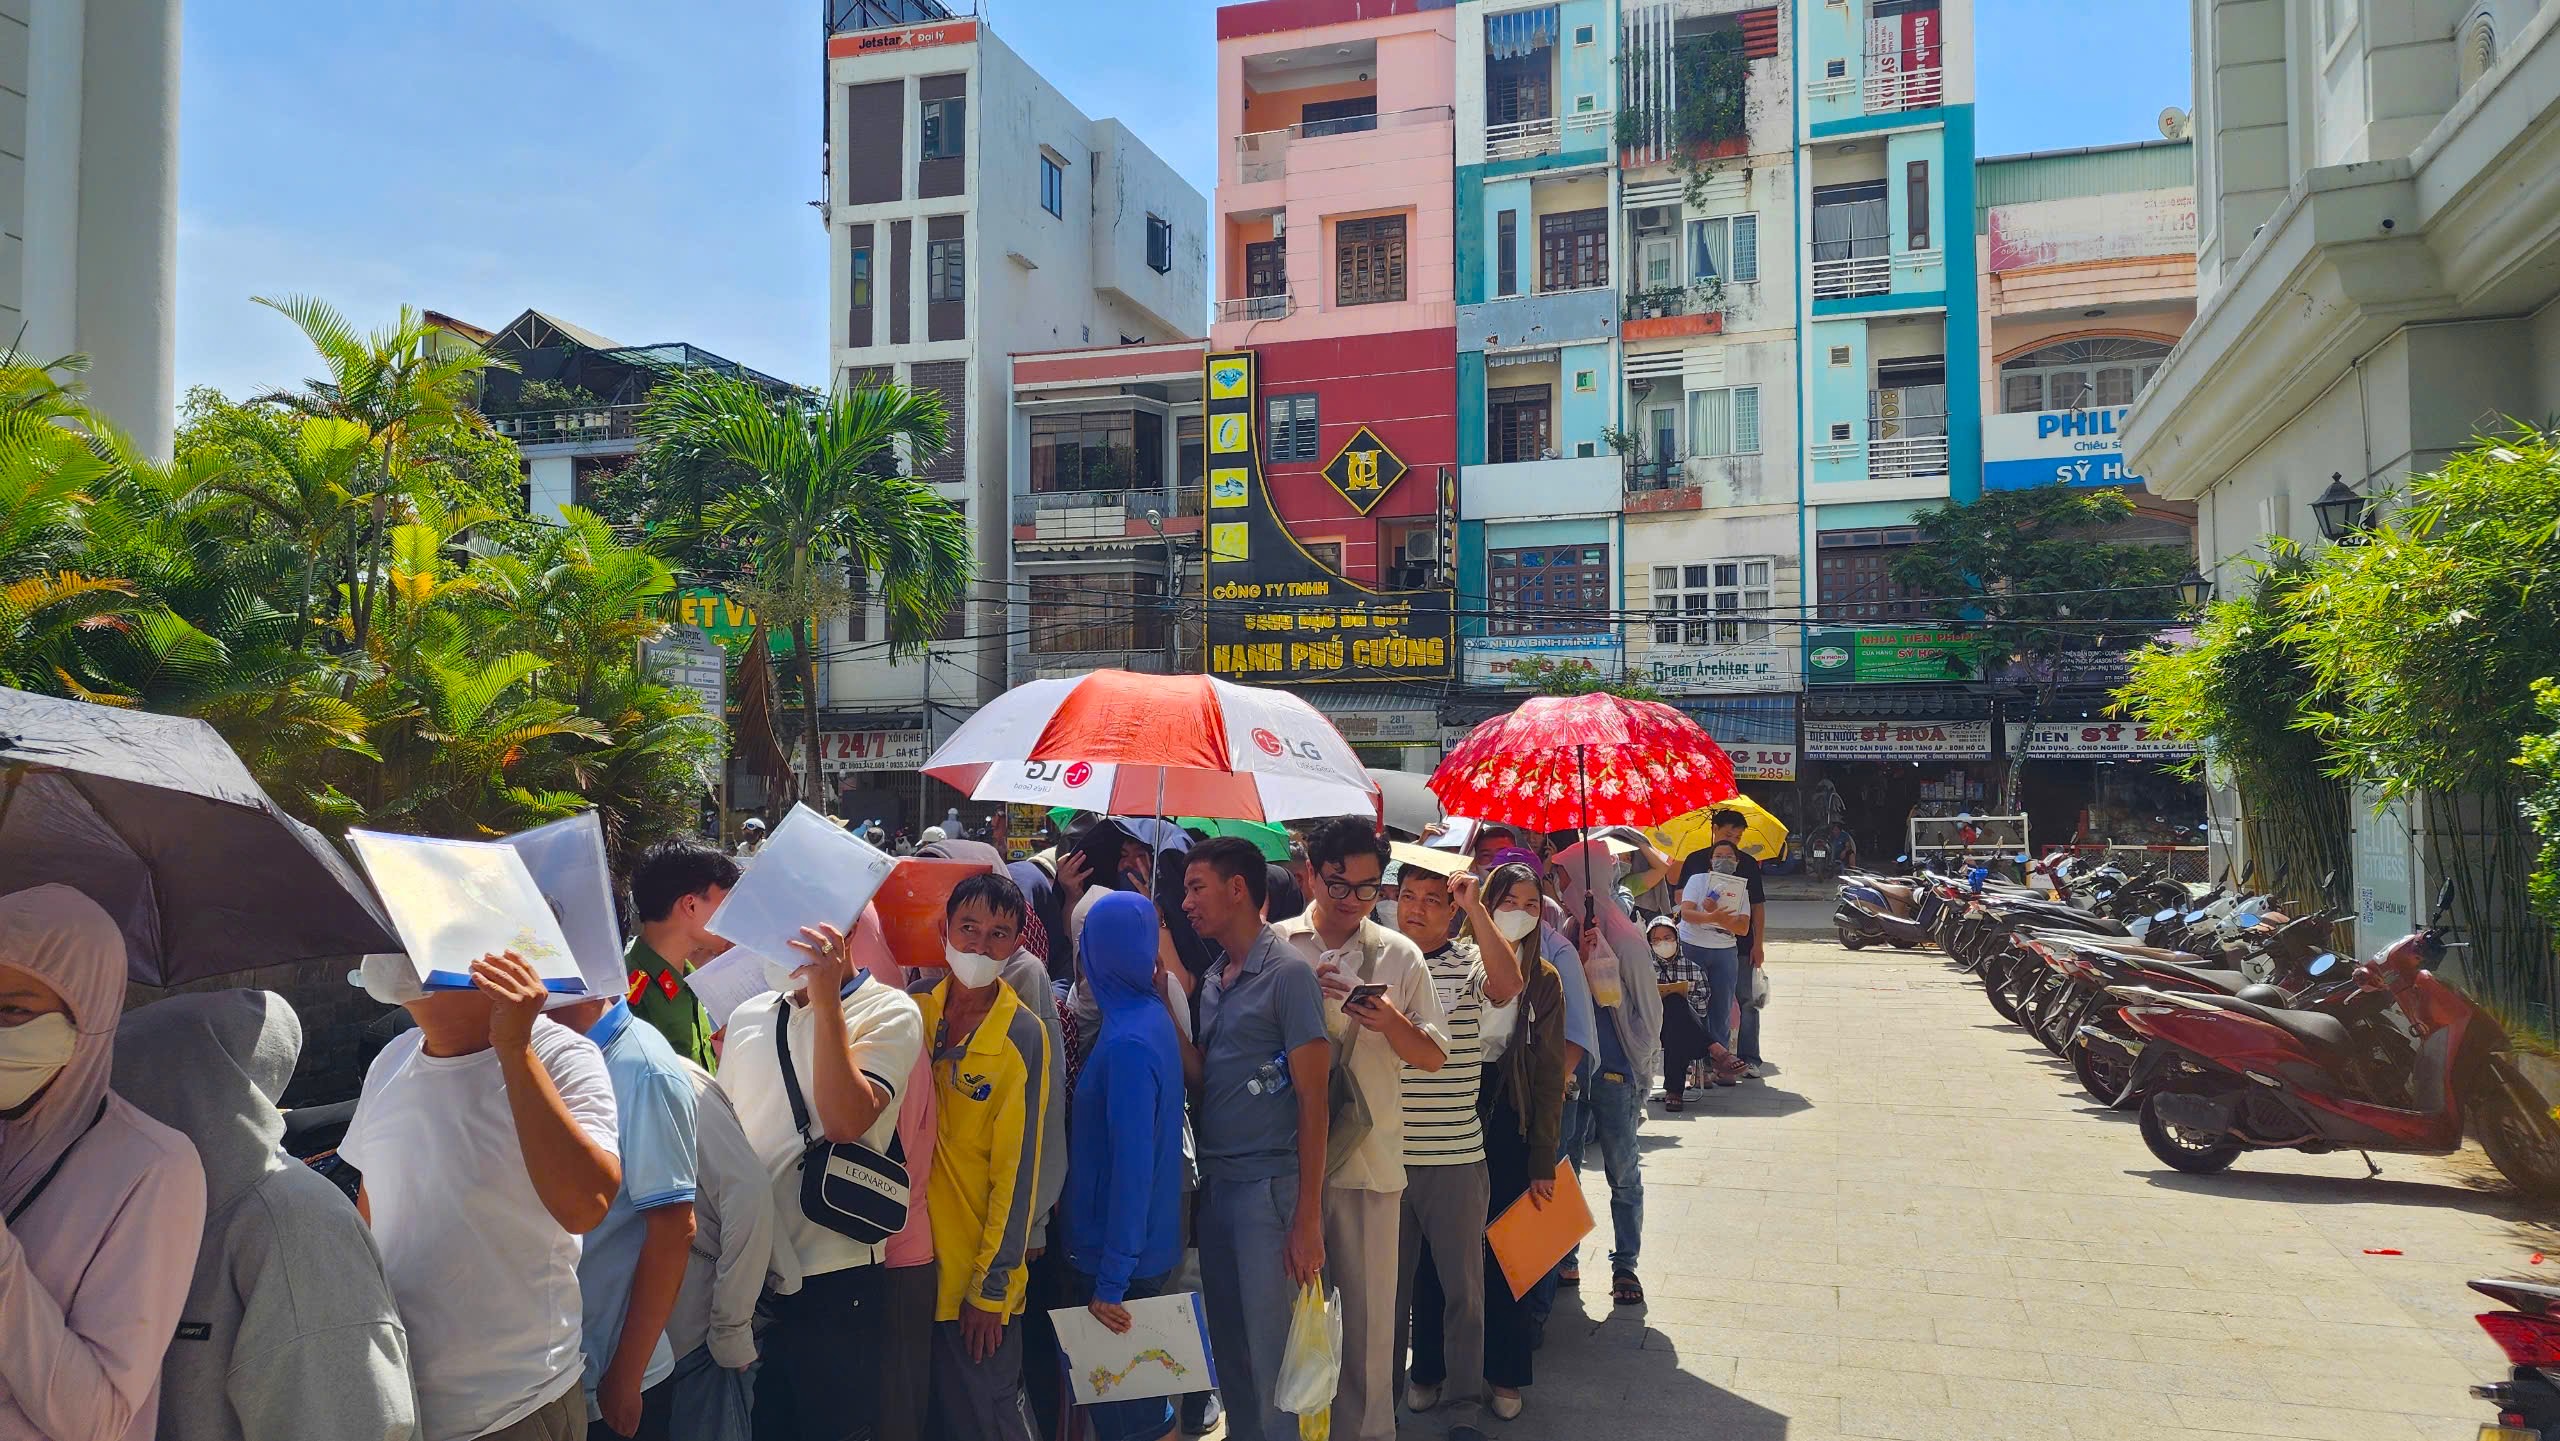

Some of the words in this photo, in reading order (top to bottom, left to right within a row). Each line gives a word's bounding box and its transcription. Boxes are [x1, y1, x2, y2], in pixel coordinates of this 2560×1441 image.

[858, 36, 901, 50] Jetstar
[917, 33, 934, 44] Đại
[1915, 16, 1929, 61] quang
[1881, 390, 1900, 440] HOA
[2056, 459, 2093, 483] SỸ
[1212, 580, 1261, 600] CÔNG
[1264, 583, 1285, 598] TY
[1286, 581, 1329, 597] TNHH
[1213, 642, 1284, 679] HẠNH
[1291, 634, 1344, 671] PHÚ
[1352, 630, 1444, 669] CƯỜNG
[1653, 660, 1692, 683] Green
[1390, 715, 1405, 724] 281
[837, 732, 886, 760] 24/7
[1896, 726, 1947, 742] HOA
[1283, 737, 1323, 761] LG
[1756, 751, 1792, 765] LU
[2362, 813, 2404, 856] ELITE
[2364, 854, 2406, 882] FITNESS
[845, 1166, 897, 1195] LEONARDO
